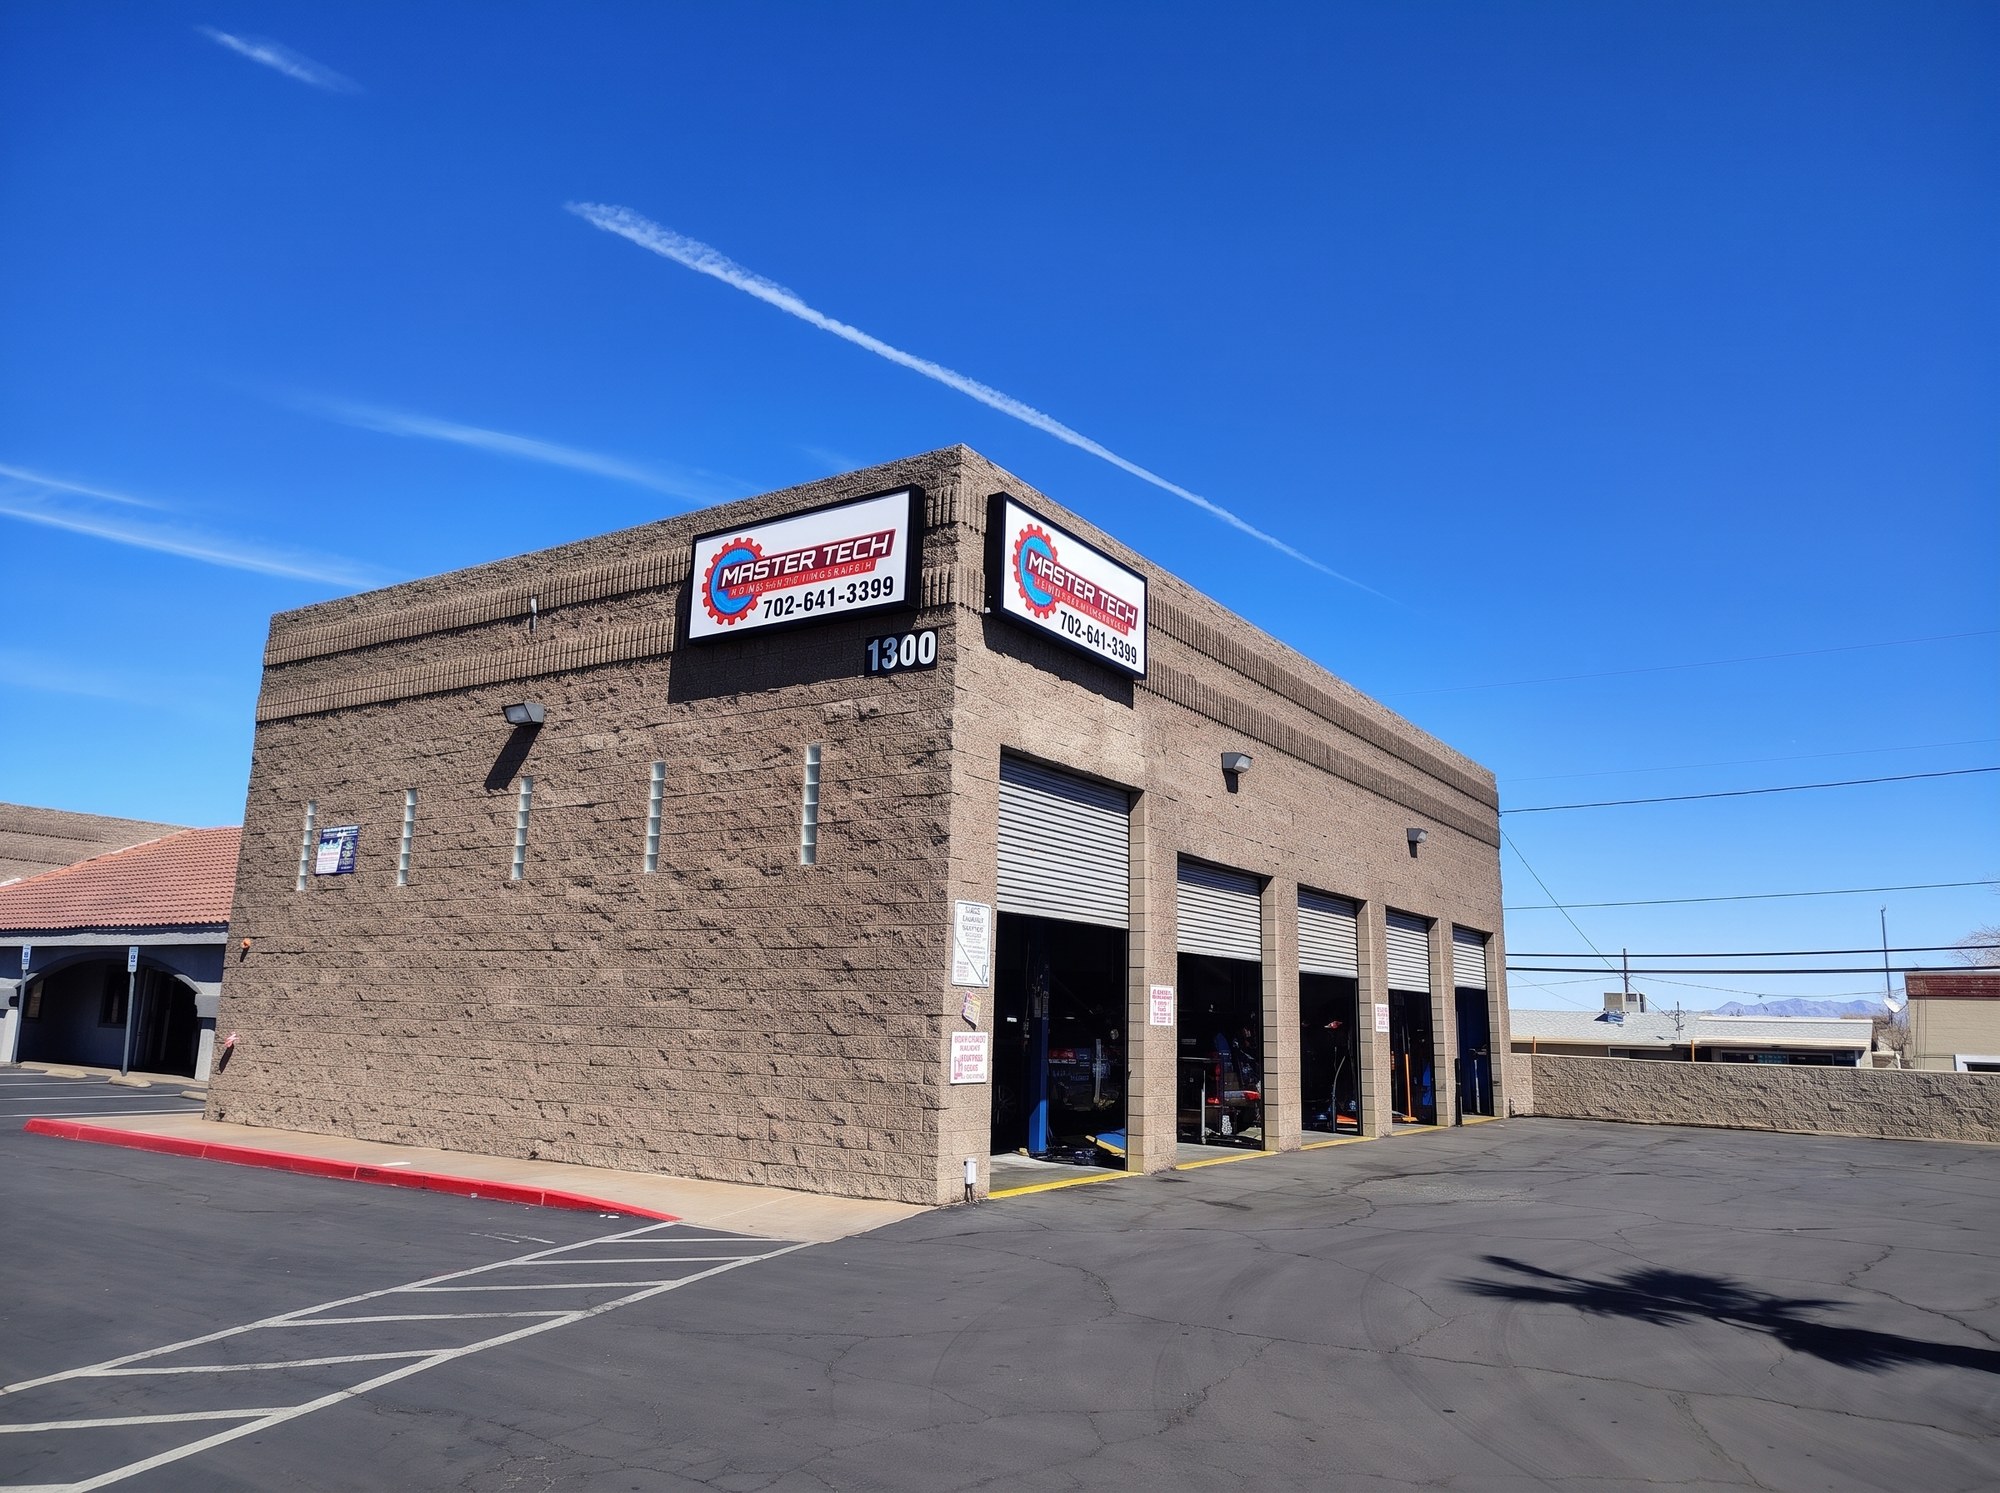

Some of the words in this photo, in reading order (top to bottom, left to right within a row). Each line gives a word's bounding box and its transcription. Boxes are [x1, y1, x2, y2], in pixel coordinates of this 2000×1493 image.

[721, 549, 816, 587] MASTER
[823, 533, 890, 564] TECH
[763, 575, 894, 619] 702-641-3399
[1028, 552, 1096, 605] MASTER
[1099, 590, 1136, 627] TECH
[867, 631, 936, 671] 1300
[1060, 610, 1137, 665] 702-641-3399
